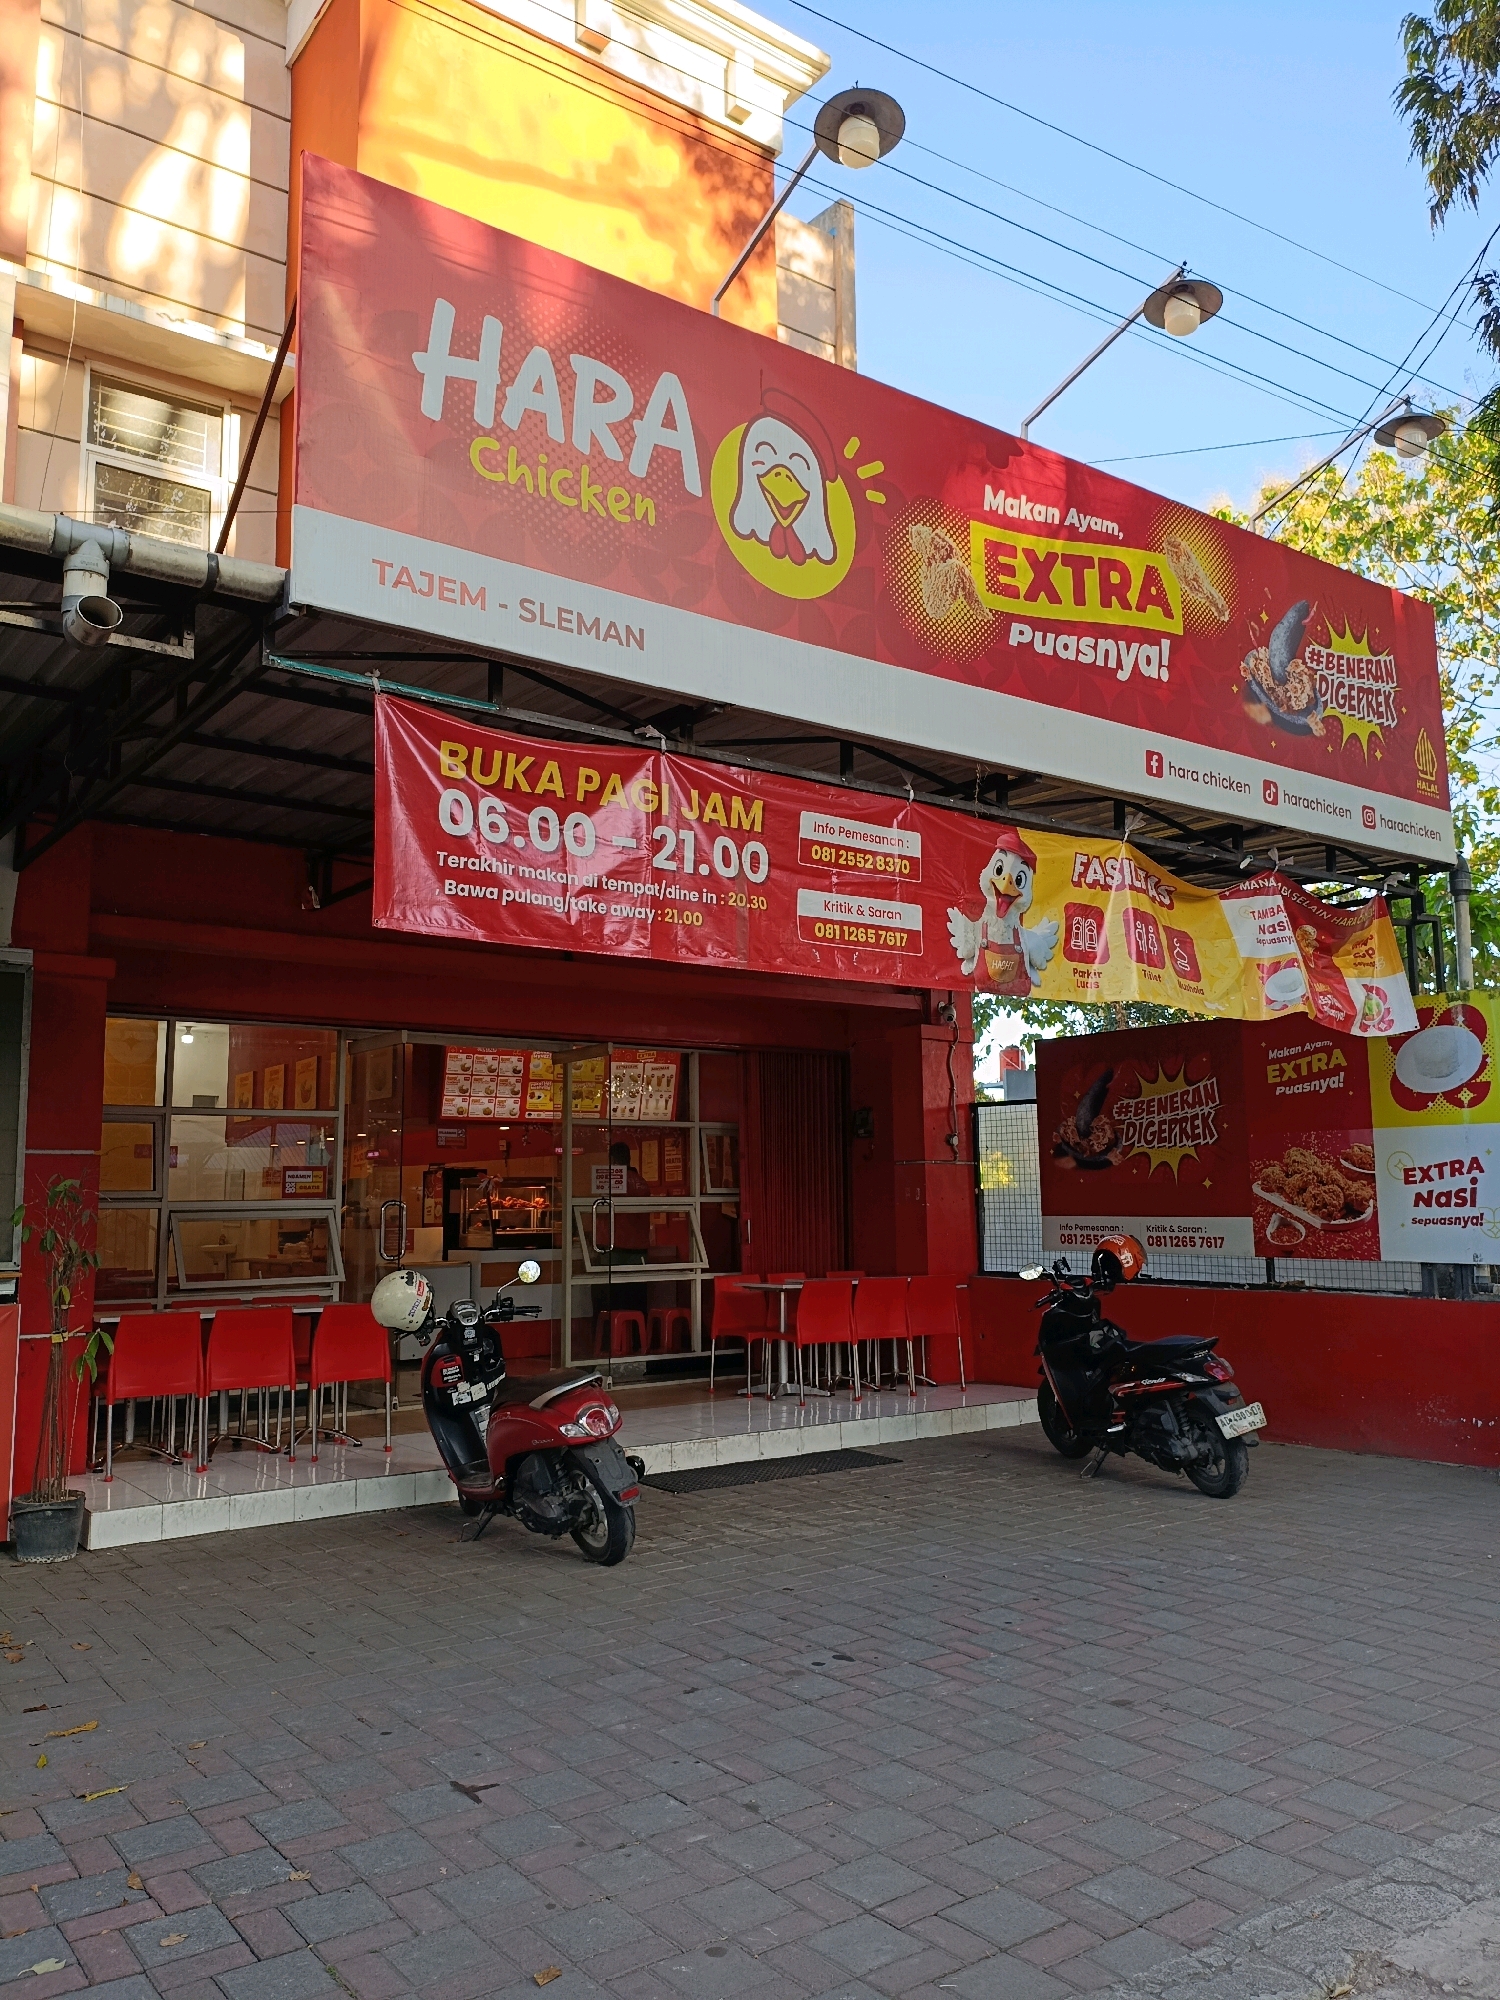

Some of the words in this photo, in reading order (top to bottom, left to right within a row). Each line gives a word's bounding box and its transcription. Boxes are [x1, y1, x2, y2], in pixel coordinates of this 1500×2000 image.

[411, 297, 703, 498] HARA
[469, 435, 657, 527] Chicken
[983, 484, 1060, 524] Makan
[1064, 507, 1124, 540] Ayam,
[983, 537, 1175, 621] EXTRA
[371, 557, 488, 612] TAJEM
[518, 597, 646, 652] SLEMAN
[1008, 622, 1171, 682] Puasnya!
[1305, 645, 1397, 686] #BENERAN
[1317, 671, 1397, 728] DIGEPREK
[439, 740, 566, 799] BUKA
[576, 766, 669, 816] PAGI
[680, 788, 764, 833] JAM
[1168, 761, 1199, 783] hara
[1202, 771, 1251, 795] chicken
[1416, 779, 1439, 794] HALAL
[1283, 789, 1352, 820] harachicken
[438, 788, 596, 857] 06.00
[652, 825, 770, 884] 21.00
[813, 821, 836, 836] Info
[838, 826, 904, 848] Pemesanan
[1379, 814, 1442, 842] harachicken
[811, 845, 836, 863] 081
[838, 849, 874, 869] 2552
[876, 855, 911, 875] 8370
[436, 850, 515, 875] Terakhir
[519, 864, 579, 886] makan
[582, 872, 598, 889] di
[601, 876, 699, 904] tempat/dine
[702, 887, 717, 905] in
[728, 891, 768, 911] 20.30
[1072, 853, 1177, 909] FASILTAS
[444, 879, 499, 901] Bawa
[502, 888, 607, 915] pulang/take
[610, 904, 656, 924] away
[664, 908, 703, 926] 21.00
[824, 899, 853, 915] Kritik
[856, 904, 866, 917] &
[868, 906, 902, 921] Saran
[1239, 876, 1277, 892] MANA
[1291, 892, 1332, 920] SELAIN
[1249, 904, 1287, 921] TAMBA
[814, 922, 840, 940] 081
[843, 925, 876, 943] 1265
[878, 930, 908, 947] 7617
[1258, 914, 1292, 935] Nasi
[992, 960, 1015, 971] HACHI
[1072, 967, 1103, 979] Parkir
[1076, 978, 1100, 989] Luas
[1268, 1045, 1301, 1060] Makan
[1304, 1040, 1333, 1052] Ayam,
[1266, 1048, 1348, 1084] EXTRA
[1113, 1077, 1220, 1120] #BENERAN
[1275, 1072, 1345, 1096] Puasnya!
[1122, 1108, 1219, 1148] DIGEPREK
[1403, 1156, 1485, 1186] EXTRA
[1413, 1176, 1479, 1208] Nasi
[1059, 1223, 1073, 1231] Info
[1075, 1223, 1120, 1232] Pemesanan
[1146, 1224, 1167, 1233] Kritik
[1169, 1225, 1176, 1233] &
[1177, 1225, 1202, 1234] Saran
[1411, 1212, 1485, 1229] Sepuasnya!
[1060, 1233, 1078, 1245] 081
[1147, 1235, 1169, 1248] 081
[1169, 1235, 1199, 1248] 1265
[1199, 1236, 1225, 1249] 7617
